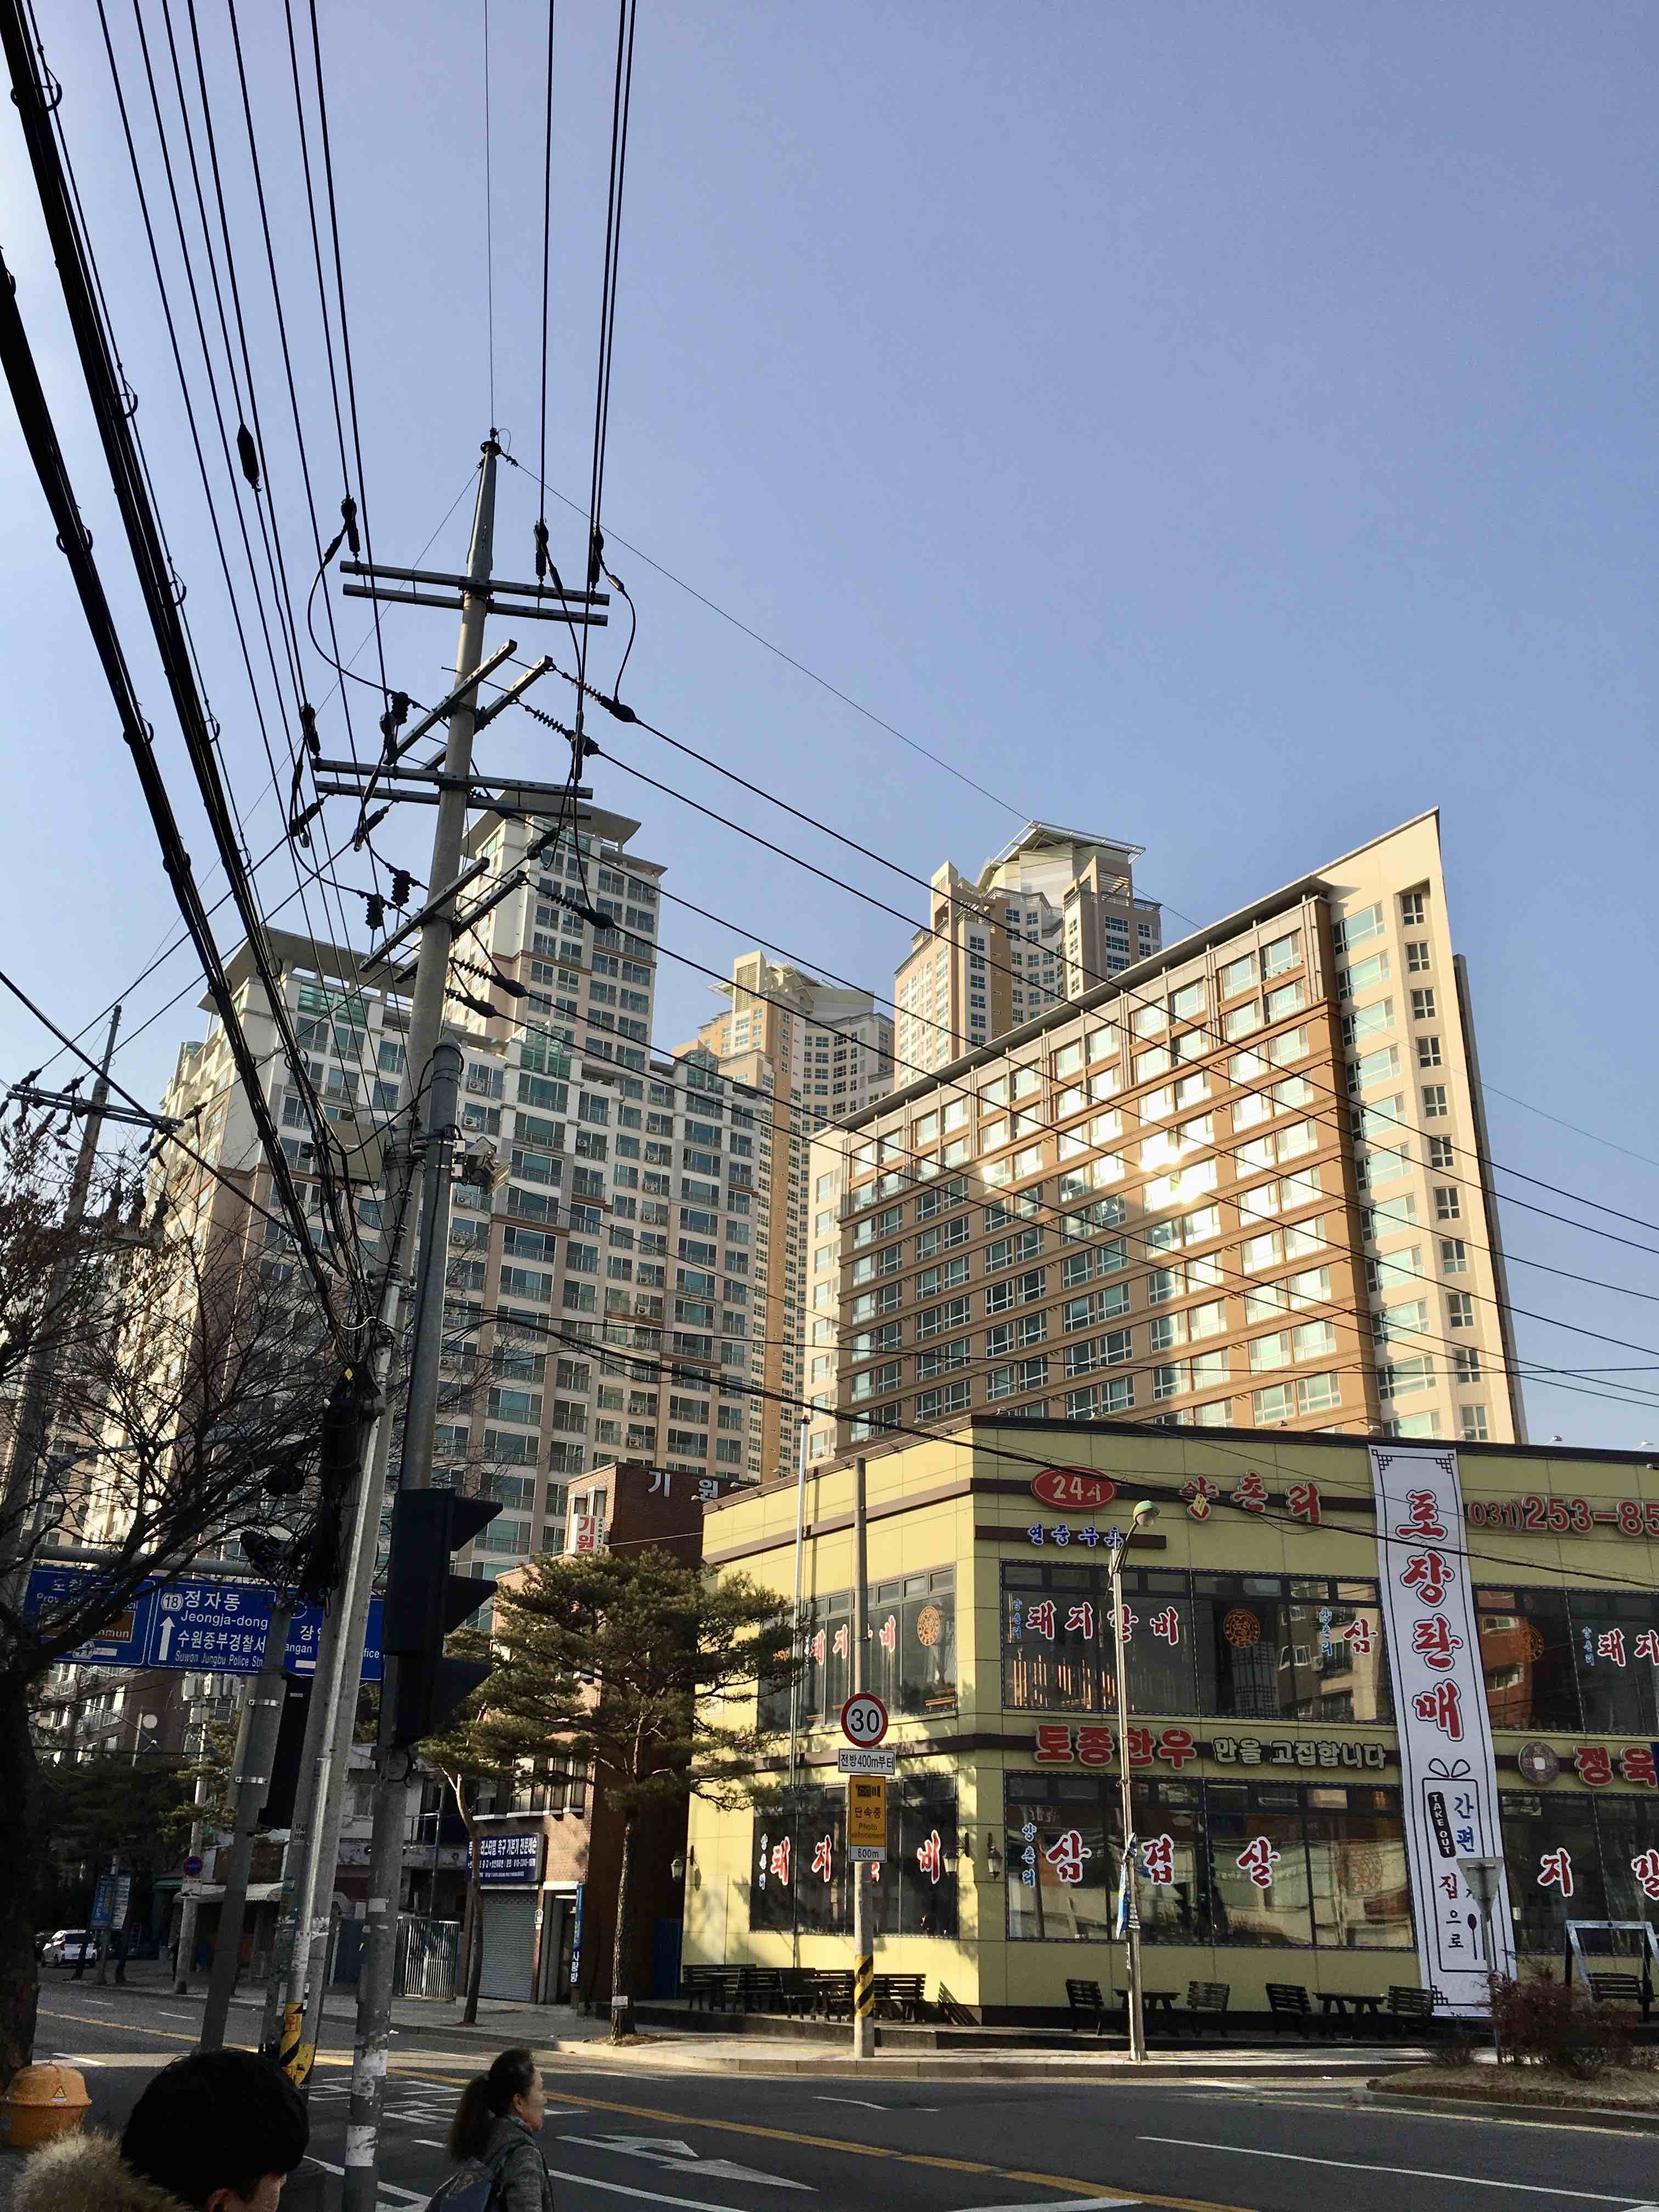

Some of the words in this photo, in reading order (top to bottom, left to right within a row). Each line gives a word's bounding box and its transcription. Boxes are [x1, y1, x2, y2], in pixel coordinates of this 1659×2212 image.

[647, 1470, 719, 1502] 기원
[1051, 1476, 1102, 1502] 24시
[1177, 1470, 1321, 1525] 양촌리
[1028, 1522, 1124, 1548] 연중무휴
[165, 1596, 179, 1609] 18
[184, 1590, 240, 1611] 정자동
[180, 1610, 269, 1630] Jeongja-dong
[1025, 1599, 1180, 1646] 돼지갈비
[1395, 1489, 1465, 1742] 포장판매
[177, 1629, 266, 1654] 수원중부경찰서
[284, 1643, 313, 1655] angan
[810, 1615, 896, 1666] 돼지비
[175, 1650, 199, 1663] Suwon
[201, 1652, 226, 1667] Jungbu
[229, 1654, 250, 1667] Police
[850, 1708, 879, 1734] 30
[1035, 1724, 1197, 1770] 토종한우
[1212, 1737, 1262, 1765] 만을
[1269, 1739, 1387, 1770] 고집합니다
[854, 1807, 882, 1819] 단속중
[1431, 1794, 1444, 1827] TAKE
[1438, 1830, 1452, 1855] OUT
[858, 1822, 878, 1831] Photo
[770, 1830, 941, 1886] 돼지비
[857, 1849, 879, 1859] 600m
[1021, 1822, 1037, 1888] 양촌리
[1045, 1830, 1282, 1889] 삼겹살
[1438, 1872, 1464, 1949] 집으로
